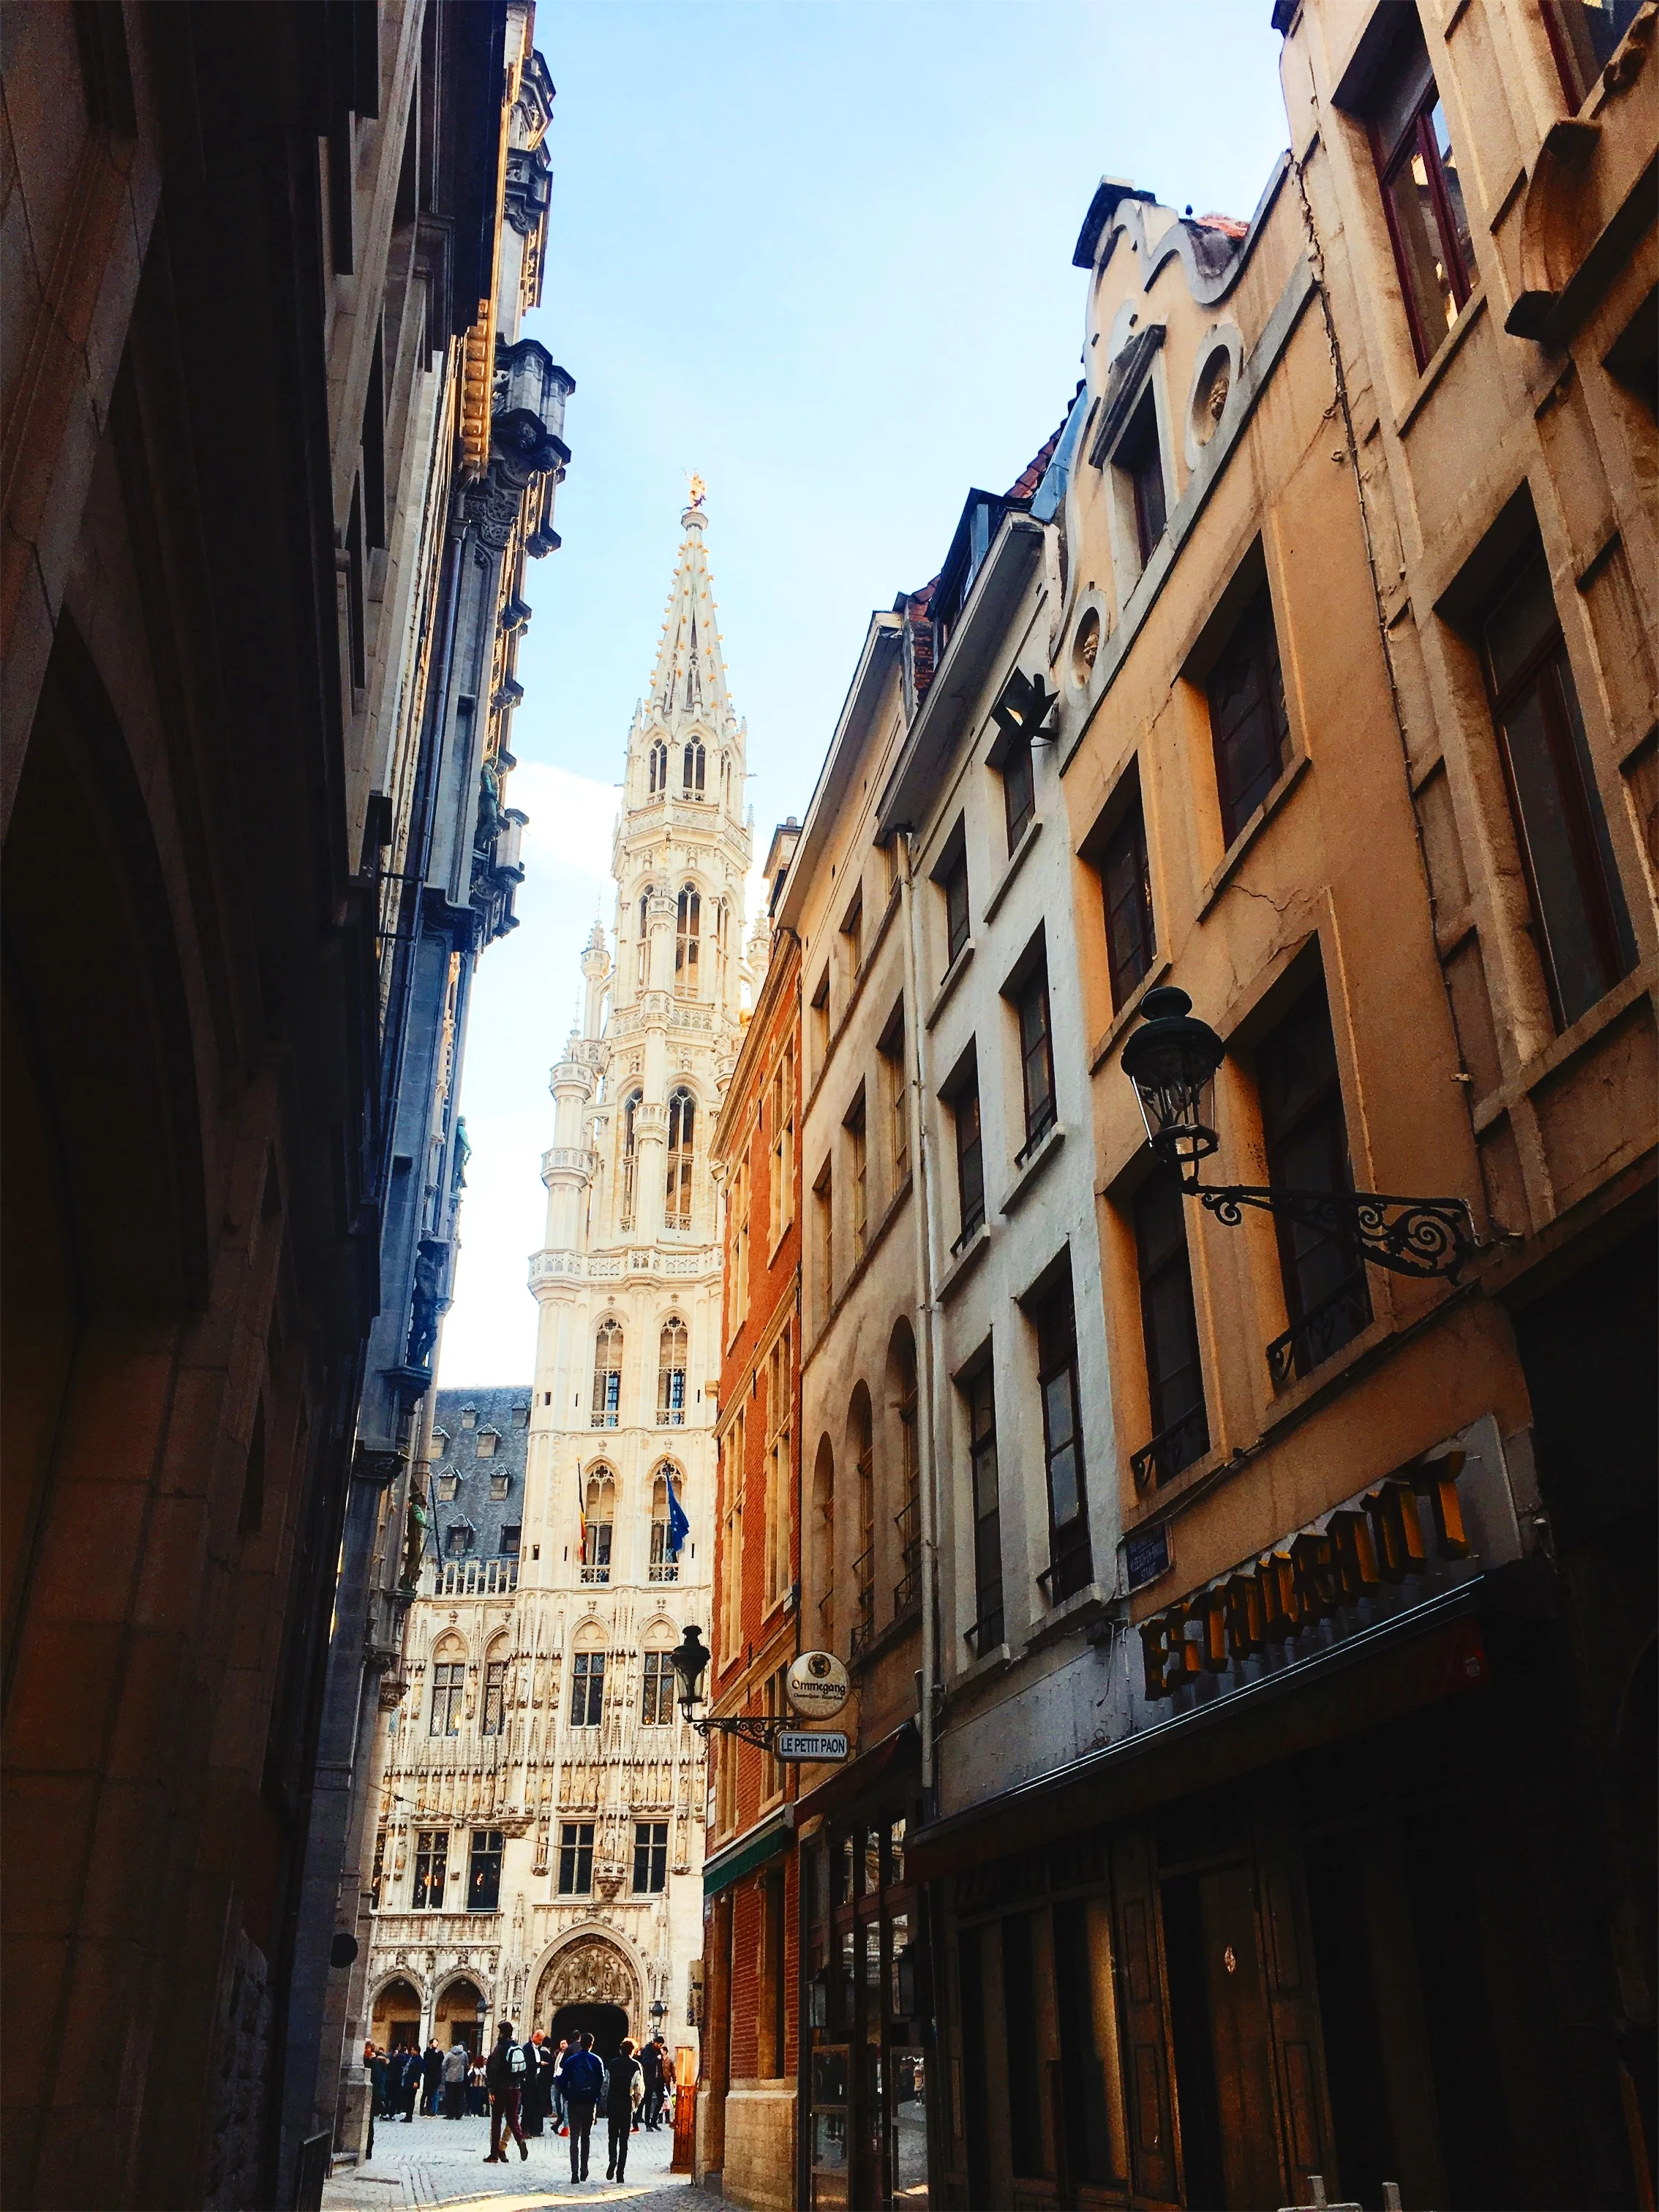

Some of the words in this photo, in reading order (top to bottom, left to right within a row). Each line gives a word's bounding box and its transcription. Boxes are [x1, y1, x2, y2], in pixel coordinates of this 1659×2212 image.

[791, 1679, 846, 1696] Ommegang
[781, 1737, 794, 1753] LE
[794, 1738, 819, 1753] PETIT
[821, 1738, 845, 1753] PAON
